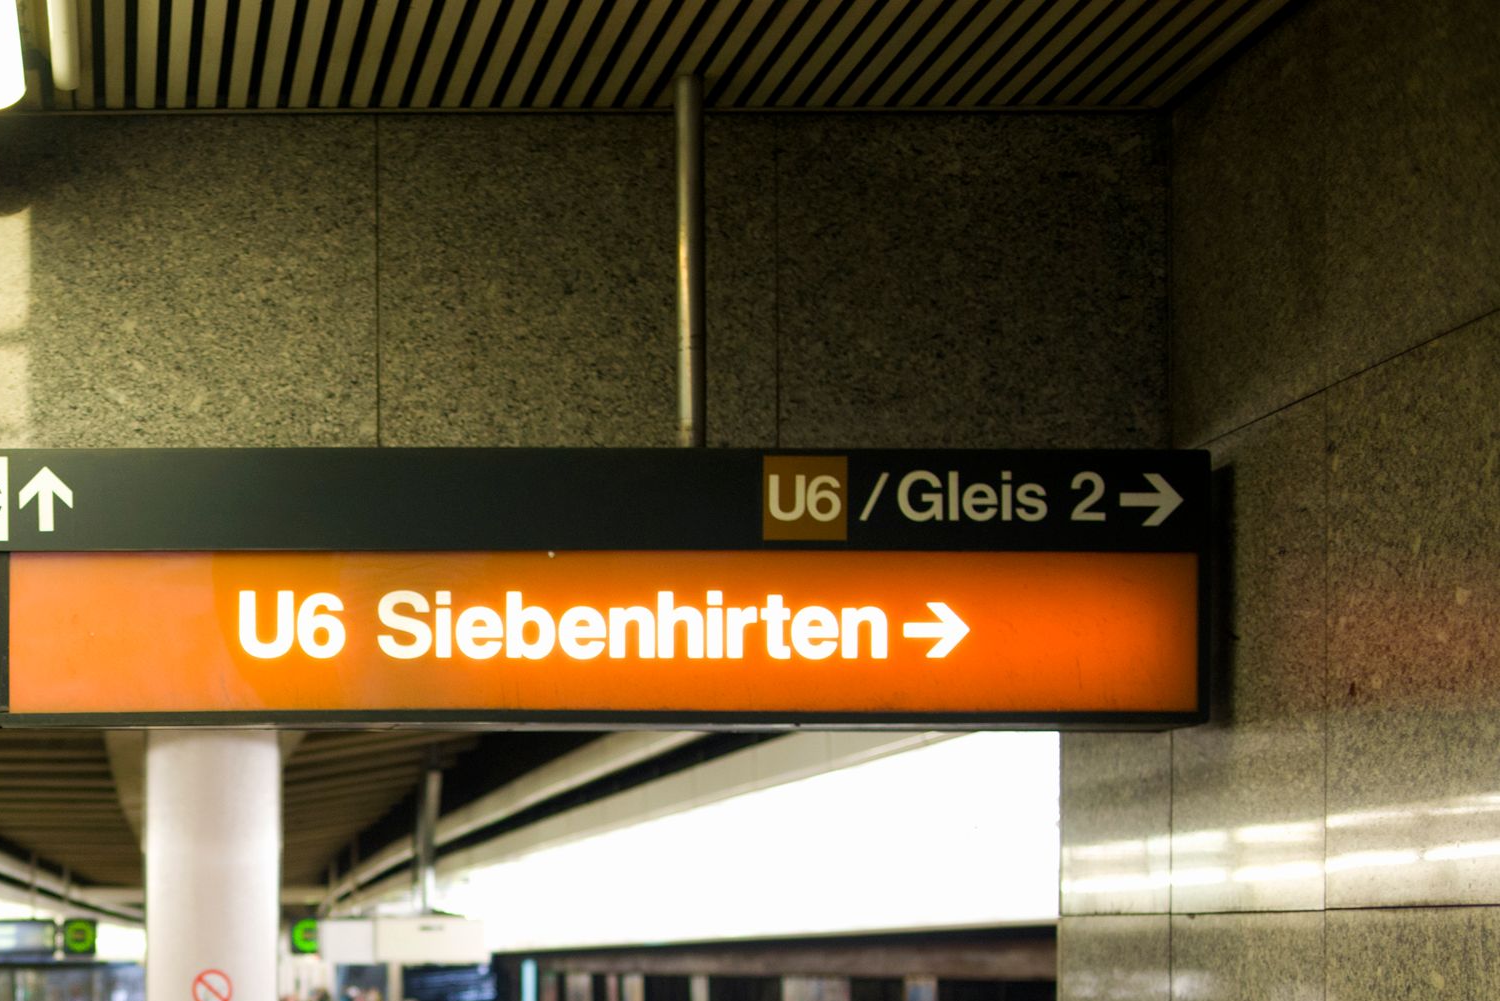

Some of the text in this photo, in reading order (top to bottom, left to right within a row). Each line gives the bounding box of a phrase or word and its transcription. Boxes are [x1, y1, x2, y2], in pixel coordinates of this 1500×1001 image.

[769, 474, 842, 521] U6
[1070, 471, 1106, 521] 2
[236, 590, 888, 660] U6 Siebenhirten
